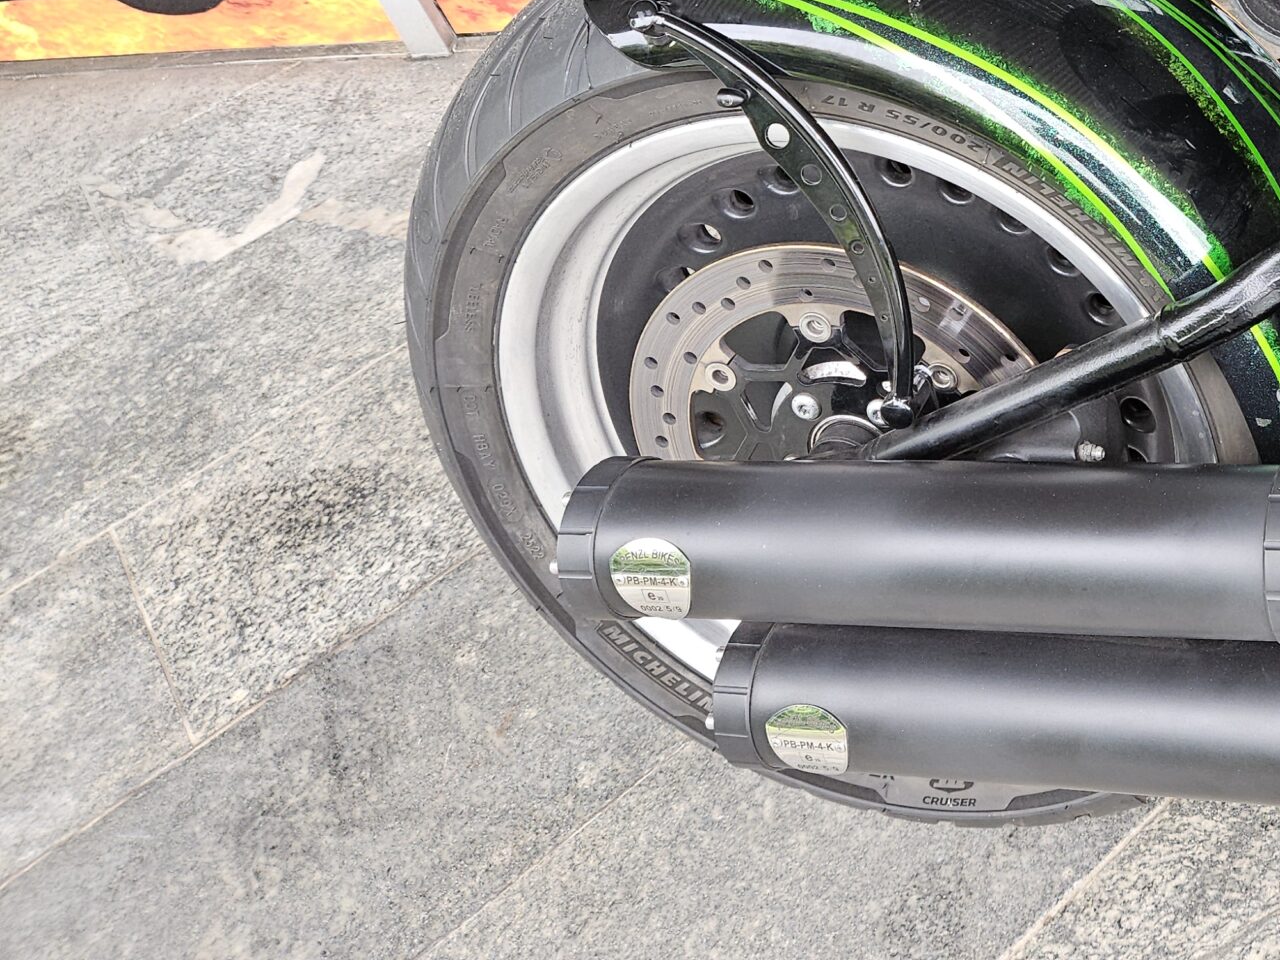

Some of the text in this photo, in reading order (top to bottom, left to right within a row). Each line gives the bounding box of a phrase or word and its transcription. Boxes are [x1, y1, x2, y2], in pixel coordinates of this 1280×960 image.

[820, 92, 986, 155] 200/55 R 17
[1002, 157, 1139, 269] MICHELIN
[463, 394, 481, 419] DOT
[519, 531, 546, 561] 2522
[651, 550, 681, 567] BIKES
[627, 576, 678, 587] PB-PM-4-K
[602, 625, 713, 713] MICHELIN
[783, 740, 834, 752] PB-PM-4-K
[922, 795, 977, 808] CRUISER
